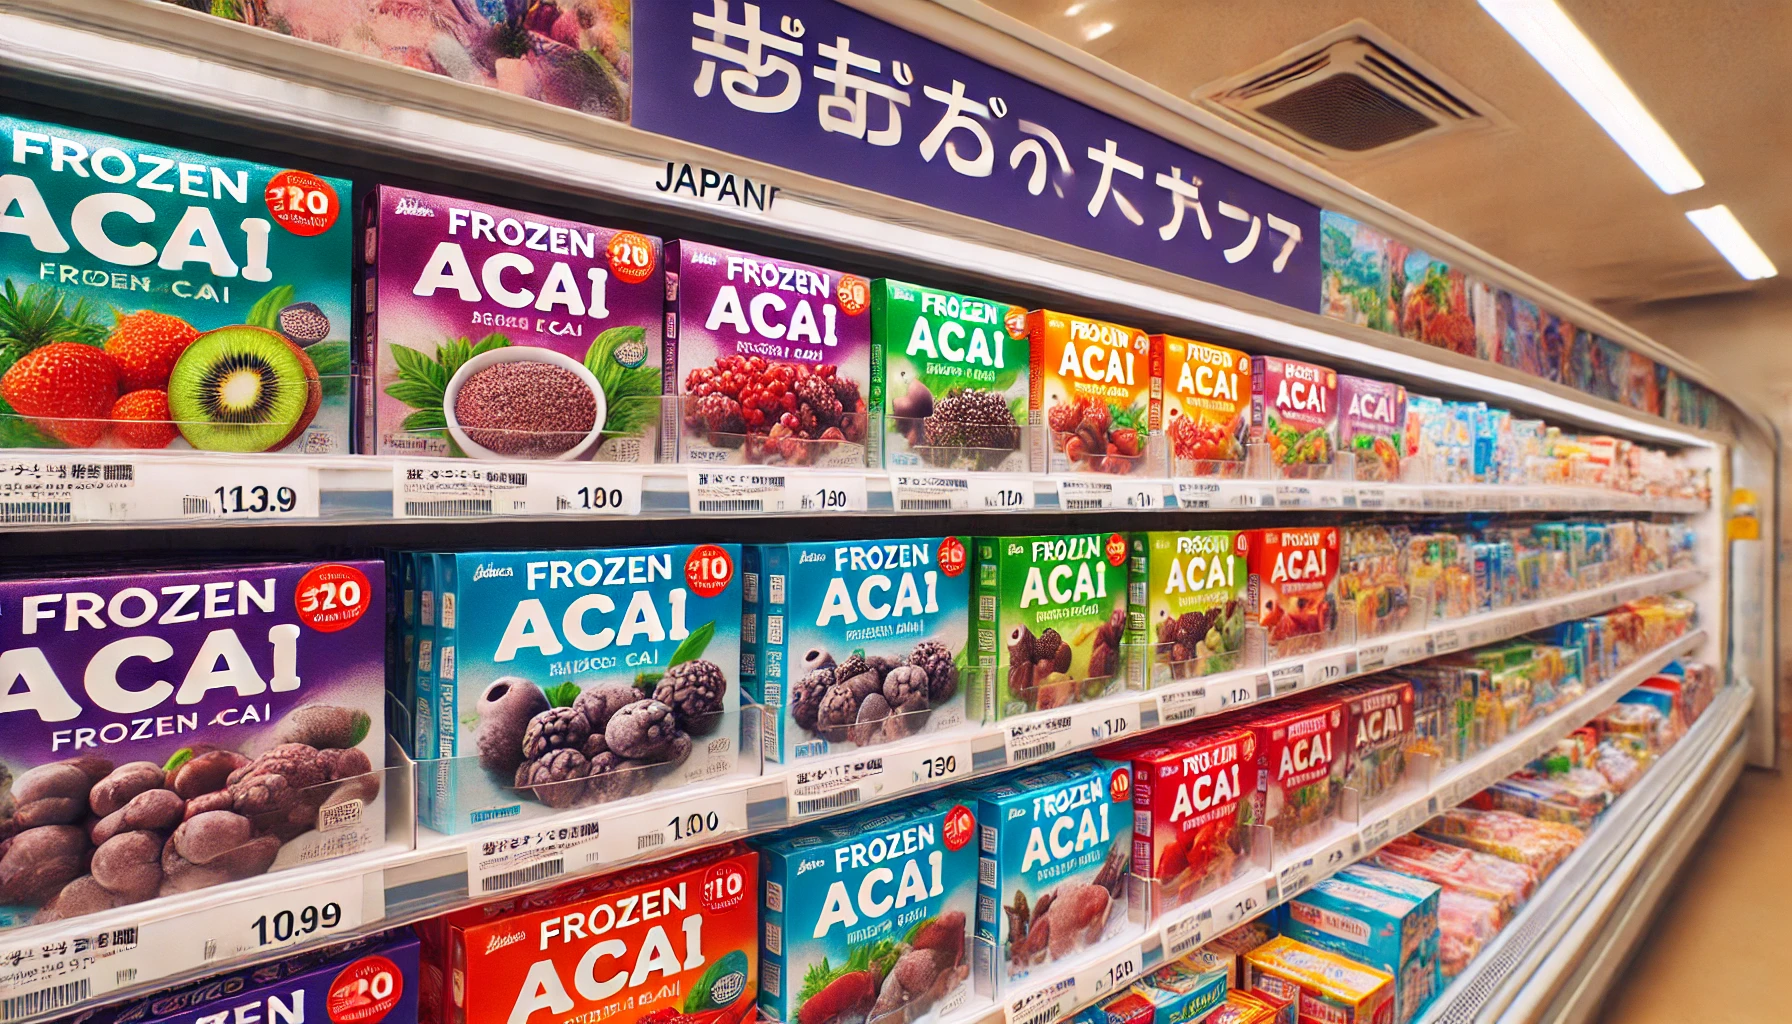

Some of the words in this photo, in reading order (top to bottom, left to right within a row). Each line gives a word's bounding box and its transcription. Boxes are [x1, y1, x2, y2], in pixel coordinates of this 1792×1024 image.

[12, 129, 249, 204] FROZEN
[0, 174, 273, 283] ACAI
[448, 208, 595, 259] FROZEN
[171, 280, 230, 304] CAI
[412, 241, 610, 319] ACAI
[727, 256, 830, 299] FROZEN
[705, 285, 838, 347] ACAI
[905, 319, 1005, 369] ACAI
[1058, 341, 1135, 386] ACAI
[1177, 362, 1239, 401] ACAI
[1276, 379, 1326, 413] ACAI
[1348, 393, 1396, 423] ACAI
[526, 554, 672, 591] FROZEN
[834, 543, 929, 571] FROZEN
[1165, 554, 1235, 594] ACAI
[1271, 548, 1327, 583] ACAI
[22, 578, 277, 635] FROZEN
[816, 570, 939, 626] ACAI
[1020, 561, 1107, 608] ACAI
[494, 588, 689, 662] ACAI
[0, 623, 302, 723] ACAI
[52, 712, 198, 752] FROZEN
[1356, 704, 1403, 747] ACAI
[1277, 731, 1332, 780] ACAI
[1169, 764, 1241, 822] ACAI
[835, 823, 935, 872] FROZEN
[1021, 802, 1110, 873] ACAI
[540, 882, 687, 950] FROZEN
[813, 850, 944, 938] ACAI
[251, 901, 343, 947] 10.99
[505, 914, 705, 1024] ACAI
